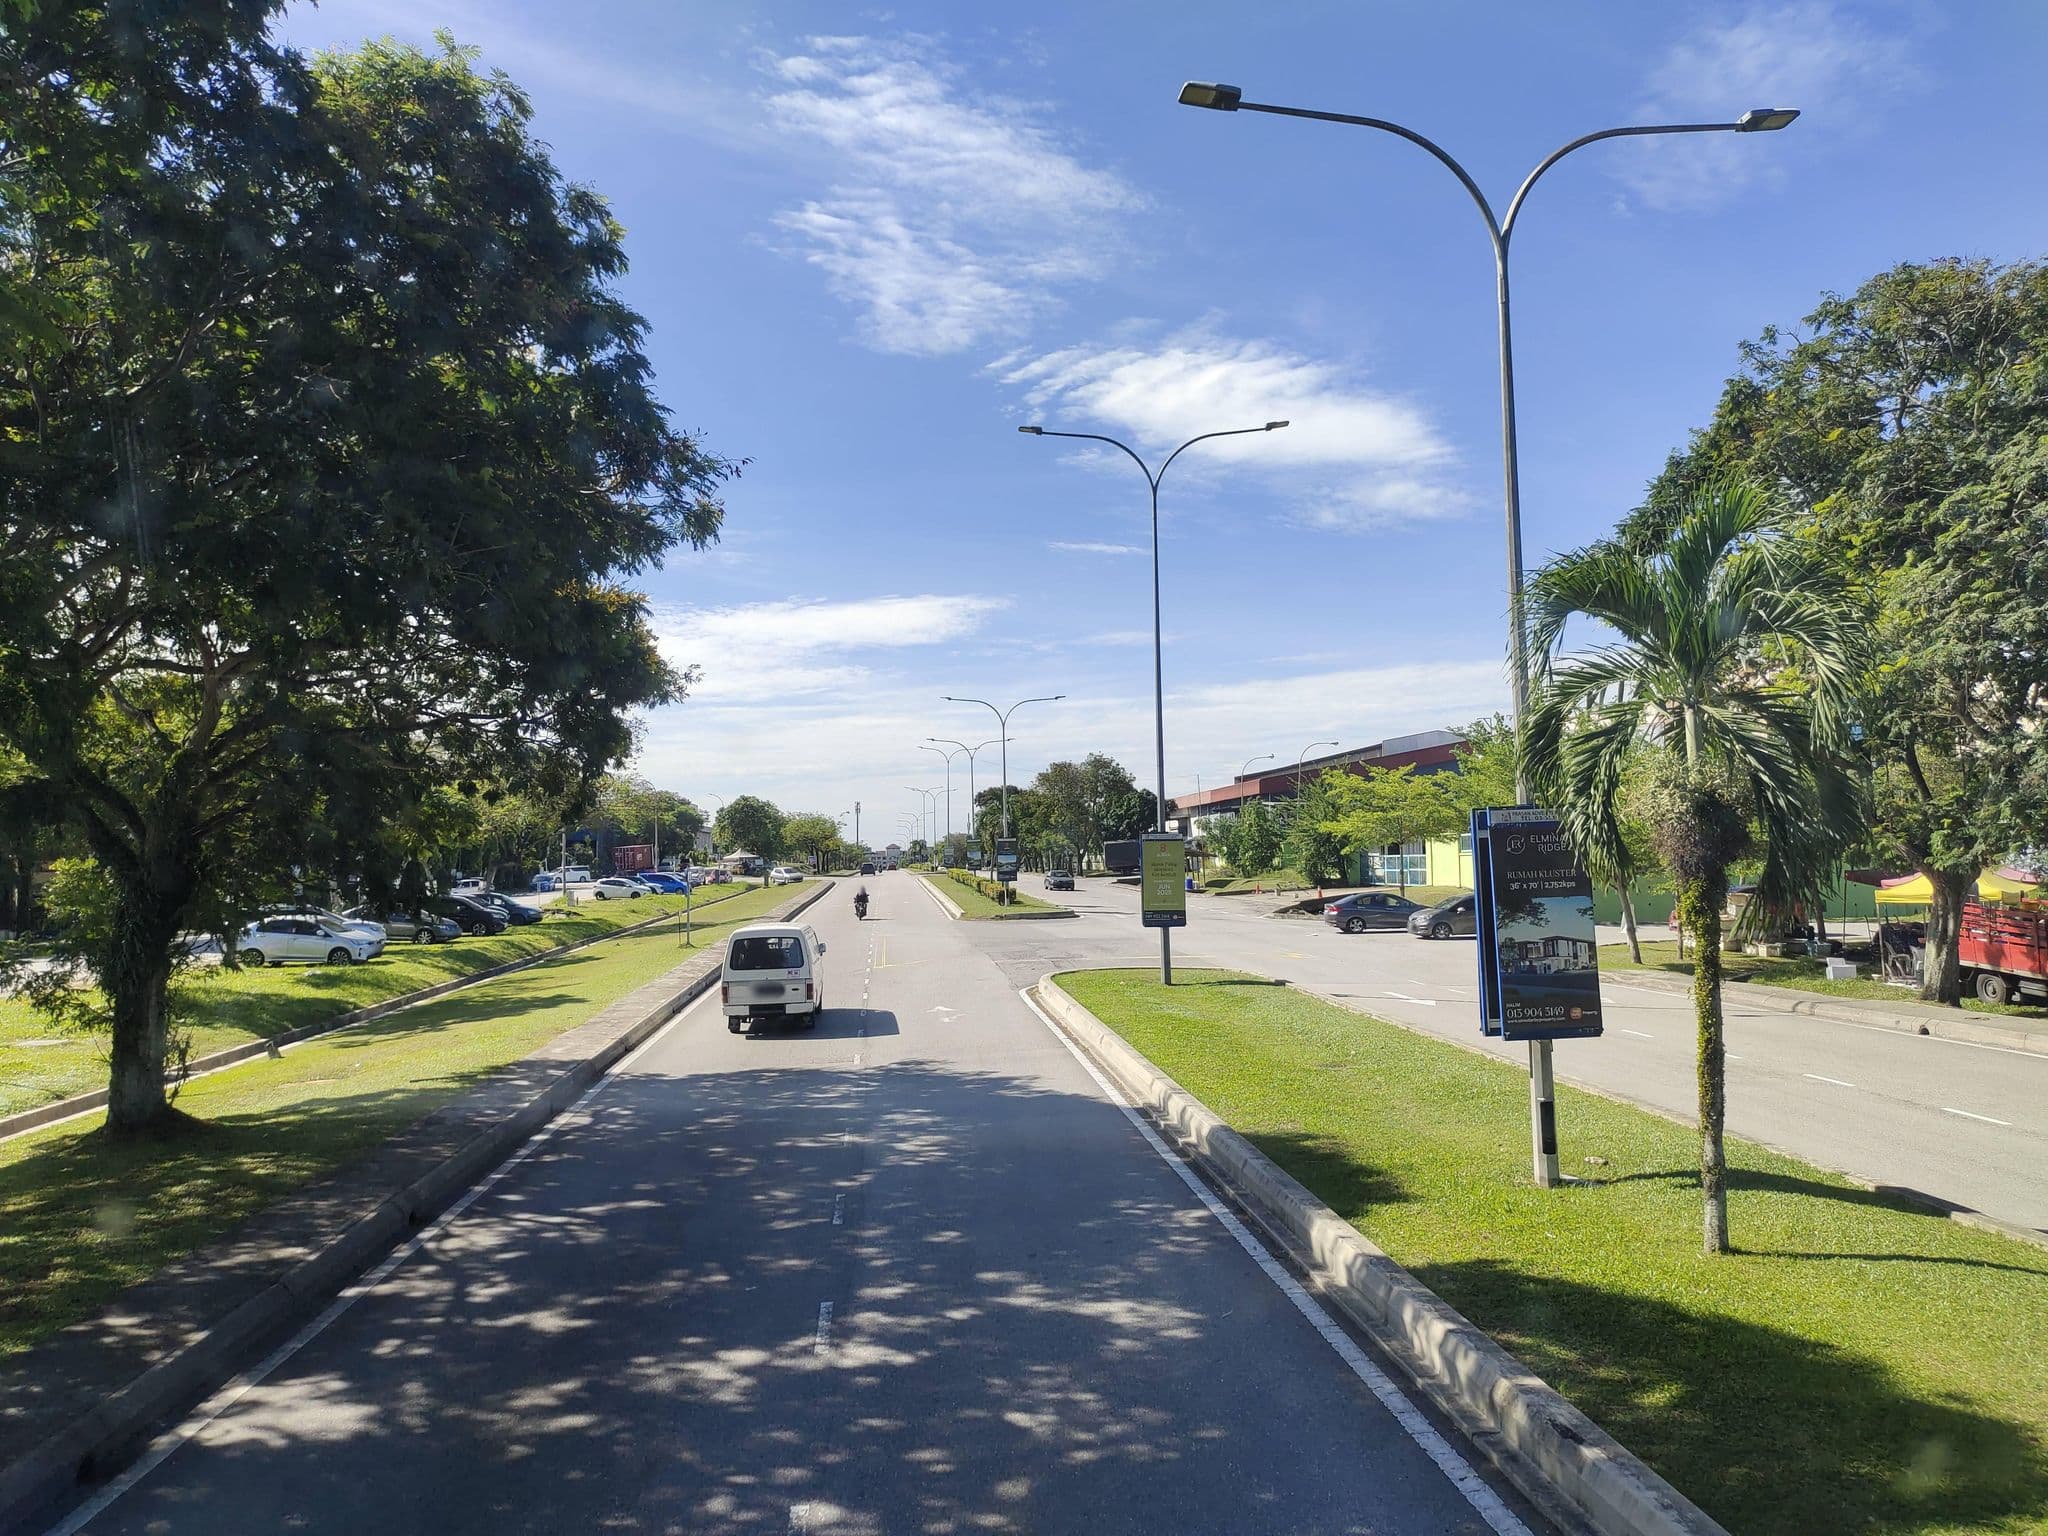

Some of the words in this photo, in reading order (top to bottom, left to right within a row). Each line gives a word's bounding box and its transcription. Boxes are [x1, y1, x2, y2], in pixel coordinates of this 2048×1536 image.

[1538, 842, 1567, 854] RIDGE
[1507, 871, 1537, 879] RUMAH
[1538, 869, 1577, 879] KLUSTER
